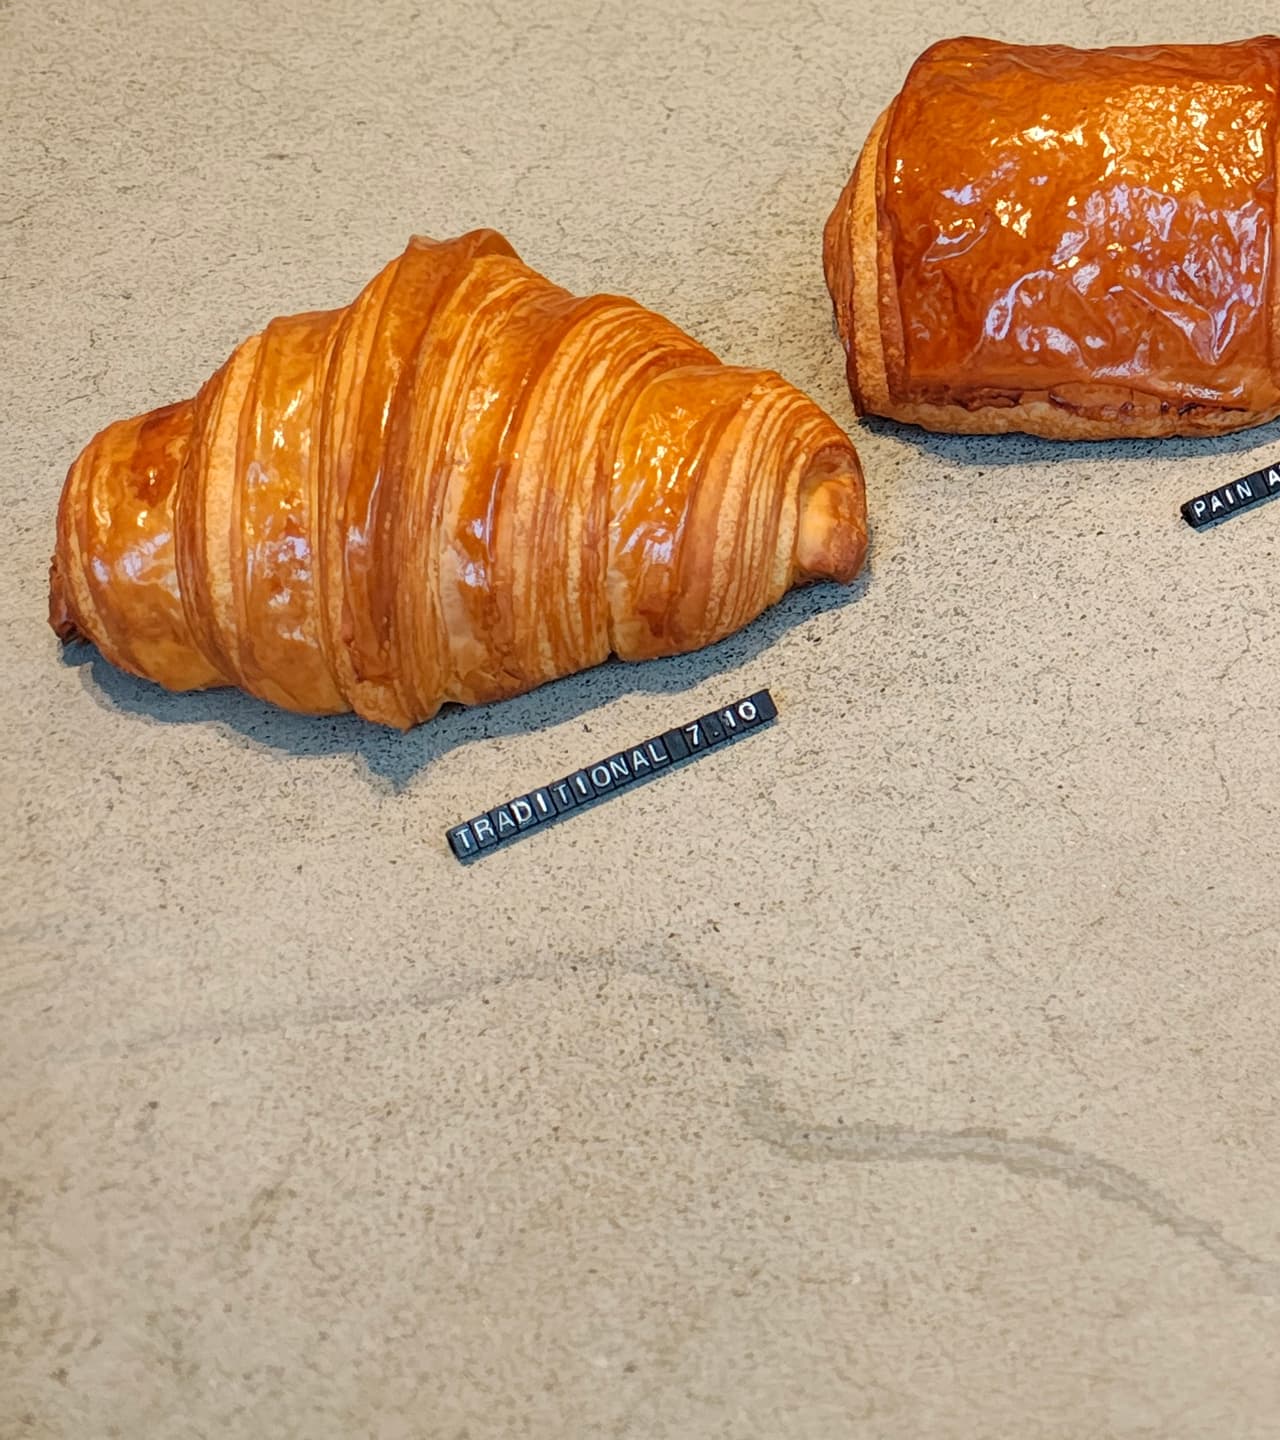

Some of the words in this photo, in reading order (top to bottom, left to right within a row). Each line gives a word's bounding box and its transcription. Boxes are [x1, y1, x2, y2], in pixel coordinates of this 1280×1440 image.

[1193, 479, 1252, 517] PAIN
[455, 742, 668, 849] TRADITIONAL
[685, 701, 757, 746] 7.10
